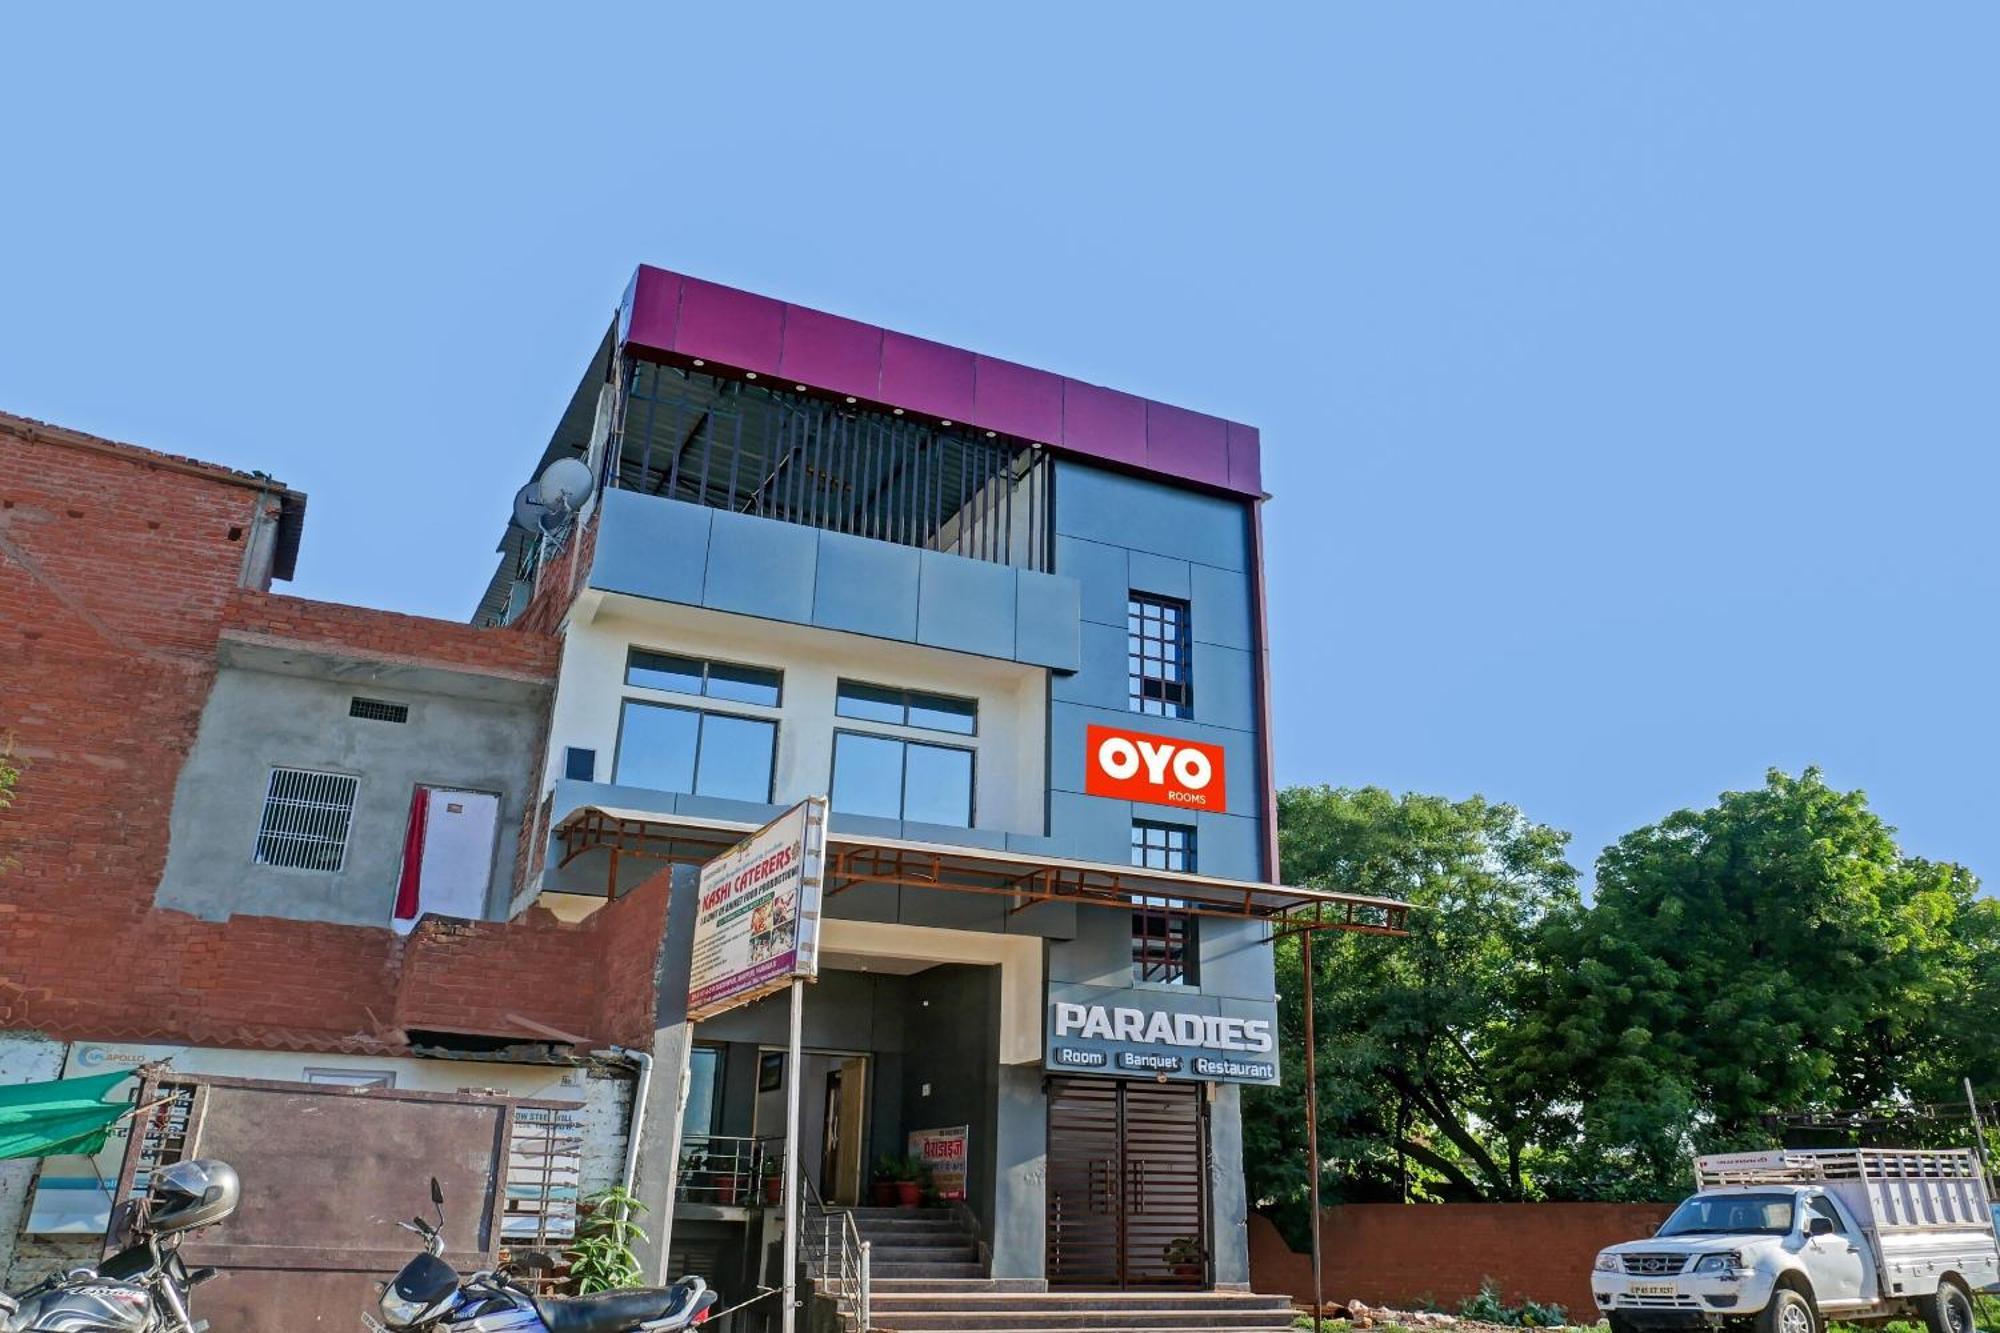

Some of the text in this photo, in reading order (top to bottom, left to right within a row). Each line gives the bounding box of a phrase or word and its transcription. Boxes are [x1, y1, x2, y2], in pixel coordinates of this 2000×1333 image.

[1098, 737, 1212, 790] OYO
[1168, 790, 1206, 805] ROOMS
[702, 882, 732, 912] KASHI
[734, 845, 792, 893] CATERERS
[1055, 1002, 1273, 1053] PARADIES
[1062, 1048, 1273, 1078] Room Banquet Restaurant
